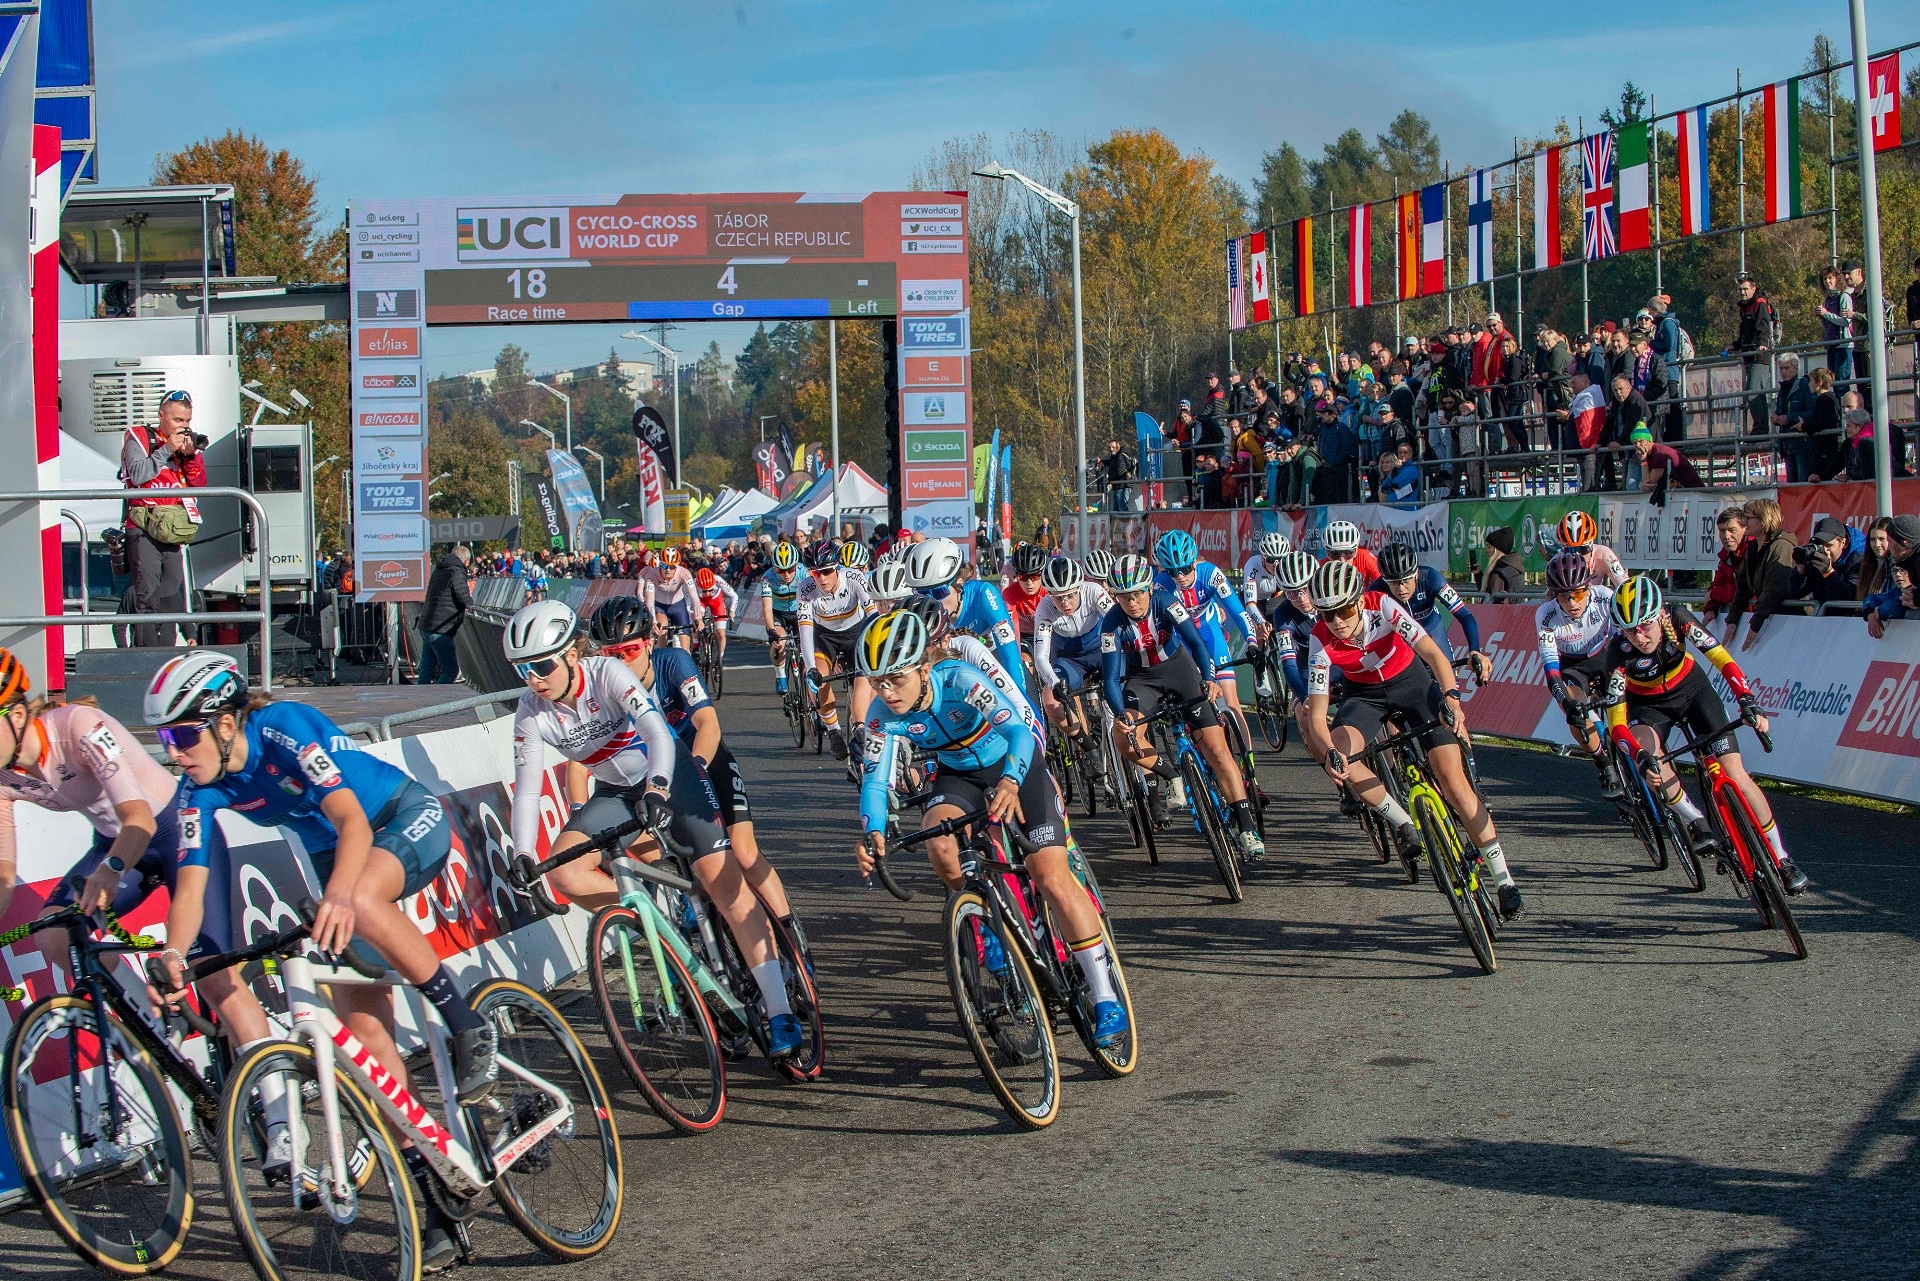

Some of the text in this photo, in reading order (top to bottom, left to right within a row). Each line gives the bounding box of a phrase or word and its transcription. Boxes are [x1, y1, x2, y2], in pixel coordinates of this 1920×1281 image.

[904, 207, 959, 216] #CXWorldCup
[379, 214, 405, 223] uci.org
[576, 214, 697, 230] CYCLO-CROSS
[714, 210, 769, 228] TÁBOR
[477, 216, 561, 250] UCI
[923, 225, 951, 233] UCI_CX
[371, 232, 413, 241] uci_cycling
[577, 233, 679, 249] WORLD CUP
[715, 231, 851, 247] CZECH REPUBLIC
[377, 250, 412, 258] ucichannel
[507, 268, 547, 299] 18
[716, 266, 738, 295] 4
[487, 305, 566, 320] Race time
[712, 302, 745, 317] Gap
[847, 300, 878, 314] Left
[908, 322, 947, 333] TOYO
[368, 329, 408, 354] ethias
[914, 332, 957, 343] TIRES
[924, 443, 961, 451] ŠKODA
[362, 461, 419, 472] Jihočeský kraj
[365, 486, 405, 497] TOYO
[912, 479, 962, 491] VIESSMANN
[371, 496, 415, 507] TIRES
[931, 516, 963, 526] KCK
[1672, 535, 1687, 554] TOI
[1701, 535, 1715, 554] TOI
[984, 588, 998, 611] wahoo
[1444, 589, 1456, 601] 22
[1099, 597, 1112, 610] 34
[1175, 607, 1184, 617] 5
[1000, 628, 1008, 638] 3
[1039, 623, 1052, 633] 34
[1399, 620, 1413, 639] 38
[1104, 639, 1111, 648] 5
[1540, 633, 1554, 643] 40
[1309, 671, 1325, 684] 38
[1611, 678, 1625, 691] 26
[688, 685, 697, 698] 7
[630, 697, 643, 710] 2
[975, 689, 992, 712] 25
[561, 720, 614, 744] PANAMERICANO
[865, 738, 883, 754] 25
[307, 754, 330, 777] 18
[728, 762, 749, 811] USA
